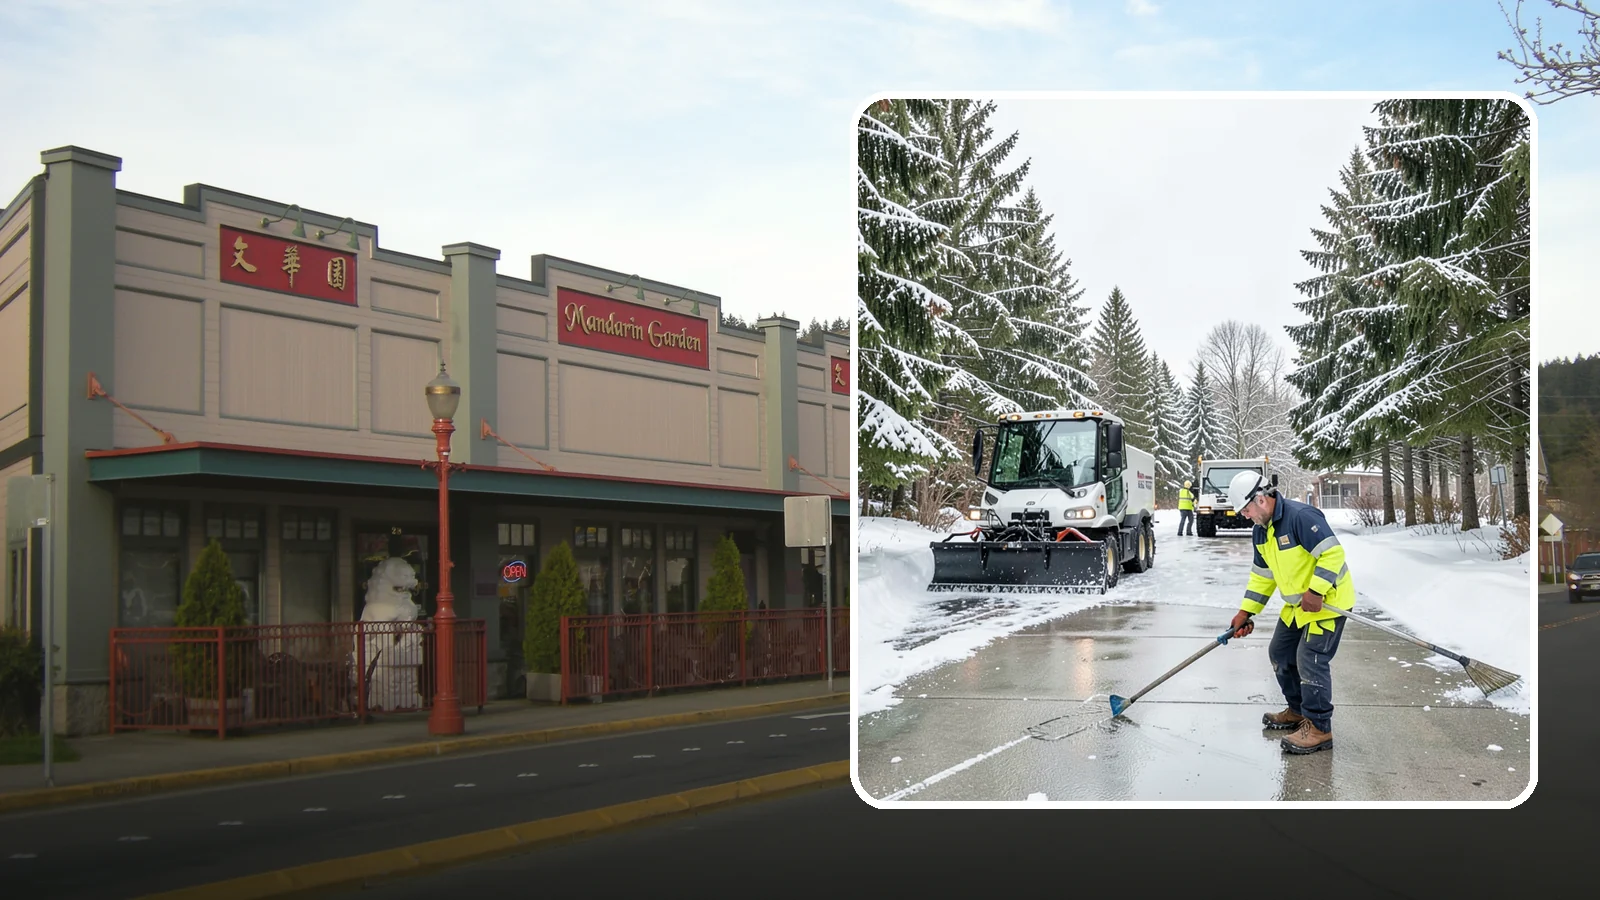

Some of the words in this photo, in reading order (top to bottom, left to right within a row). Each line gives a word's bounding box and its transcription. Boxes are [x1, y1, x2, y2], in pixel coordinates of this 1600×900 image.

[231, 236, 346, 290] 文華園
[565, 302, 644, 341] Mandarin
[648, 320, 702, 352] Garden
[834, 363, 846, 386] 文
[503, 565, 527, 578] OPEN
